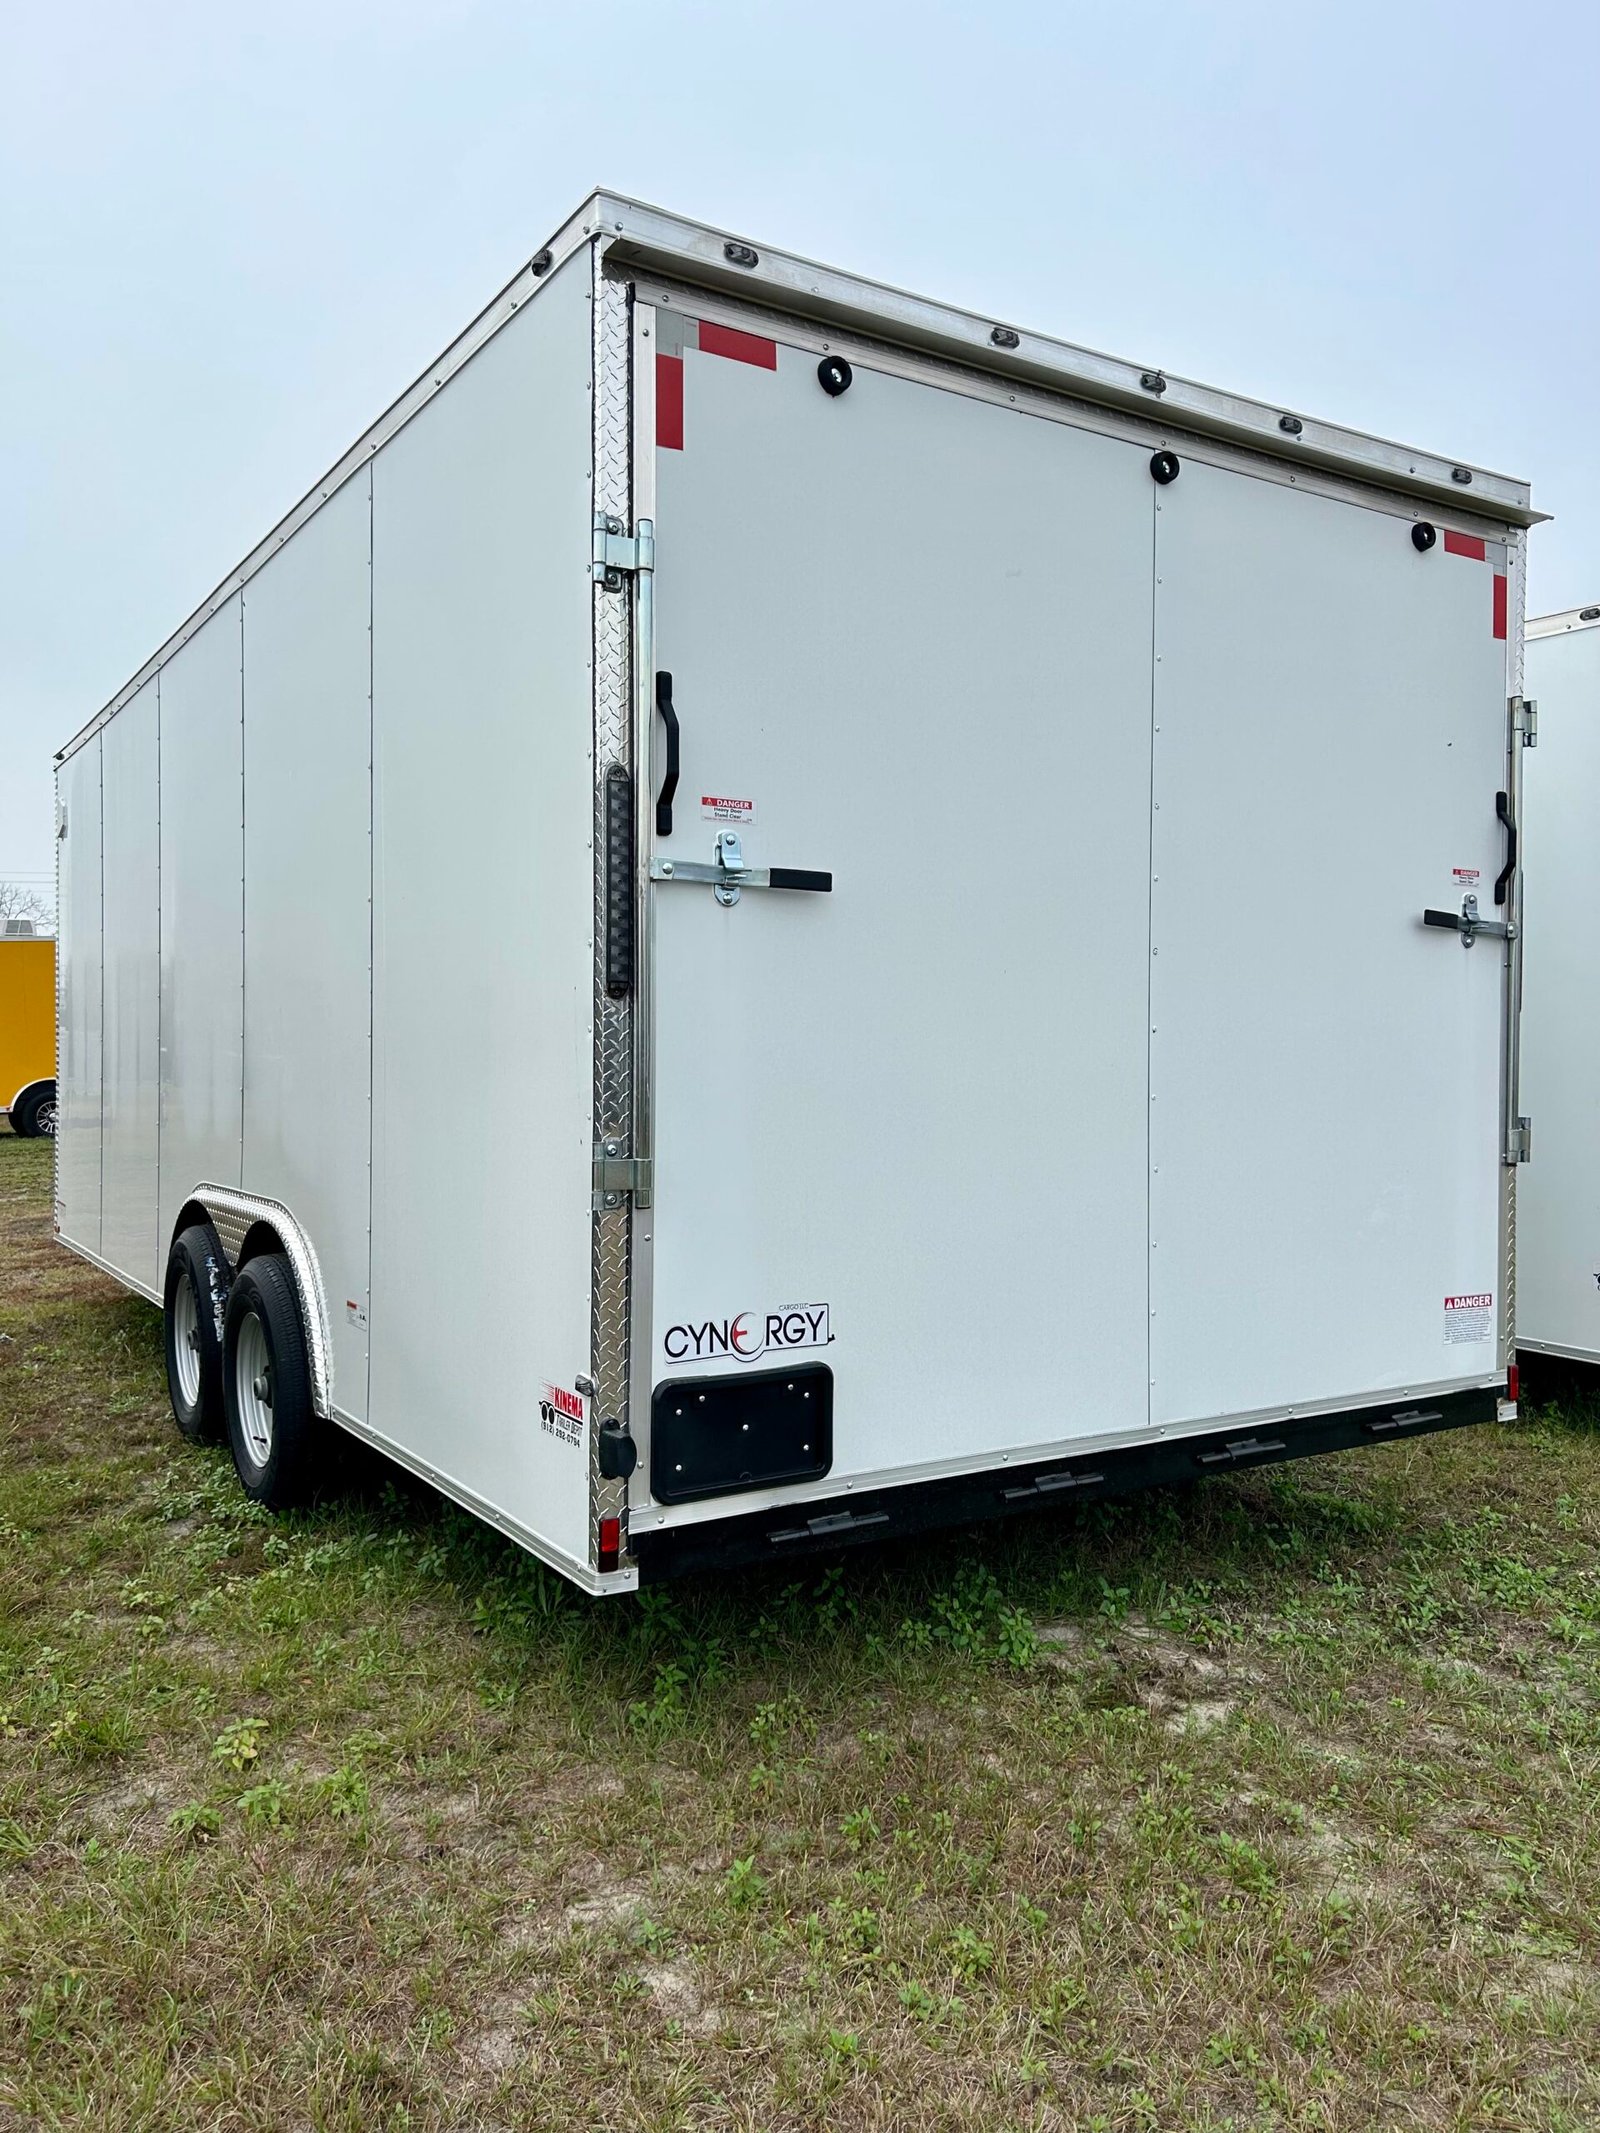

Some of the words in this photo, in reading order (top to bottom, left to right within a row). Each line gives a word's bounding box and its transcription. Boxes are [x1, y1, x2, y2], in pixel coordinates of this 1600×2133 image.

[716, 799, 750, 809] DANGER
[779, 1303, 799, 1311] CARGO
[799, 1302, 809, 1310] LLC
[1454, 1295, 1491, 1309] DANGER
[664, 1311, 825, 1358] CYNERGY
[554, 1387, 583, 1420] KINEMA
